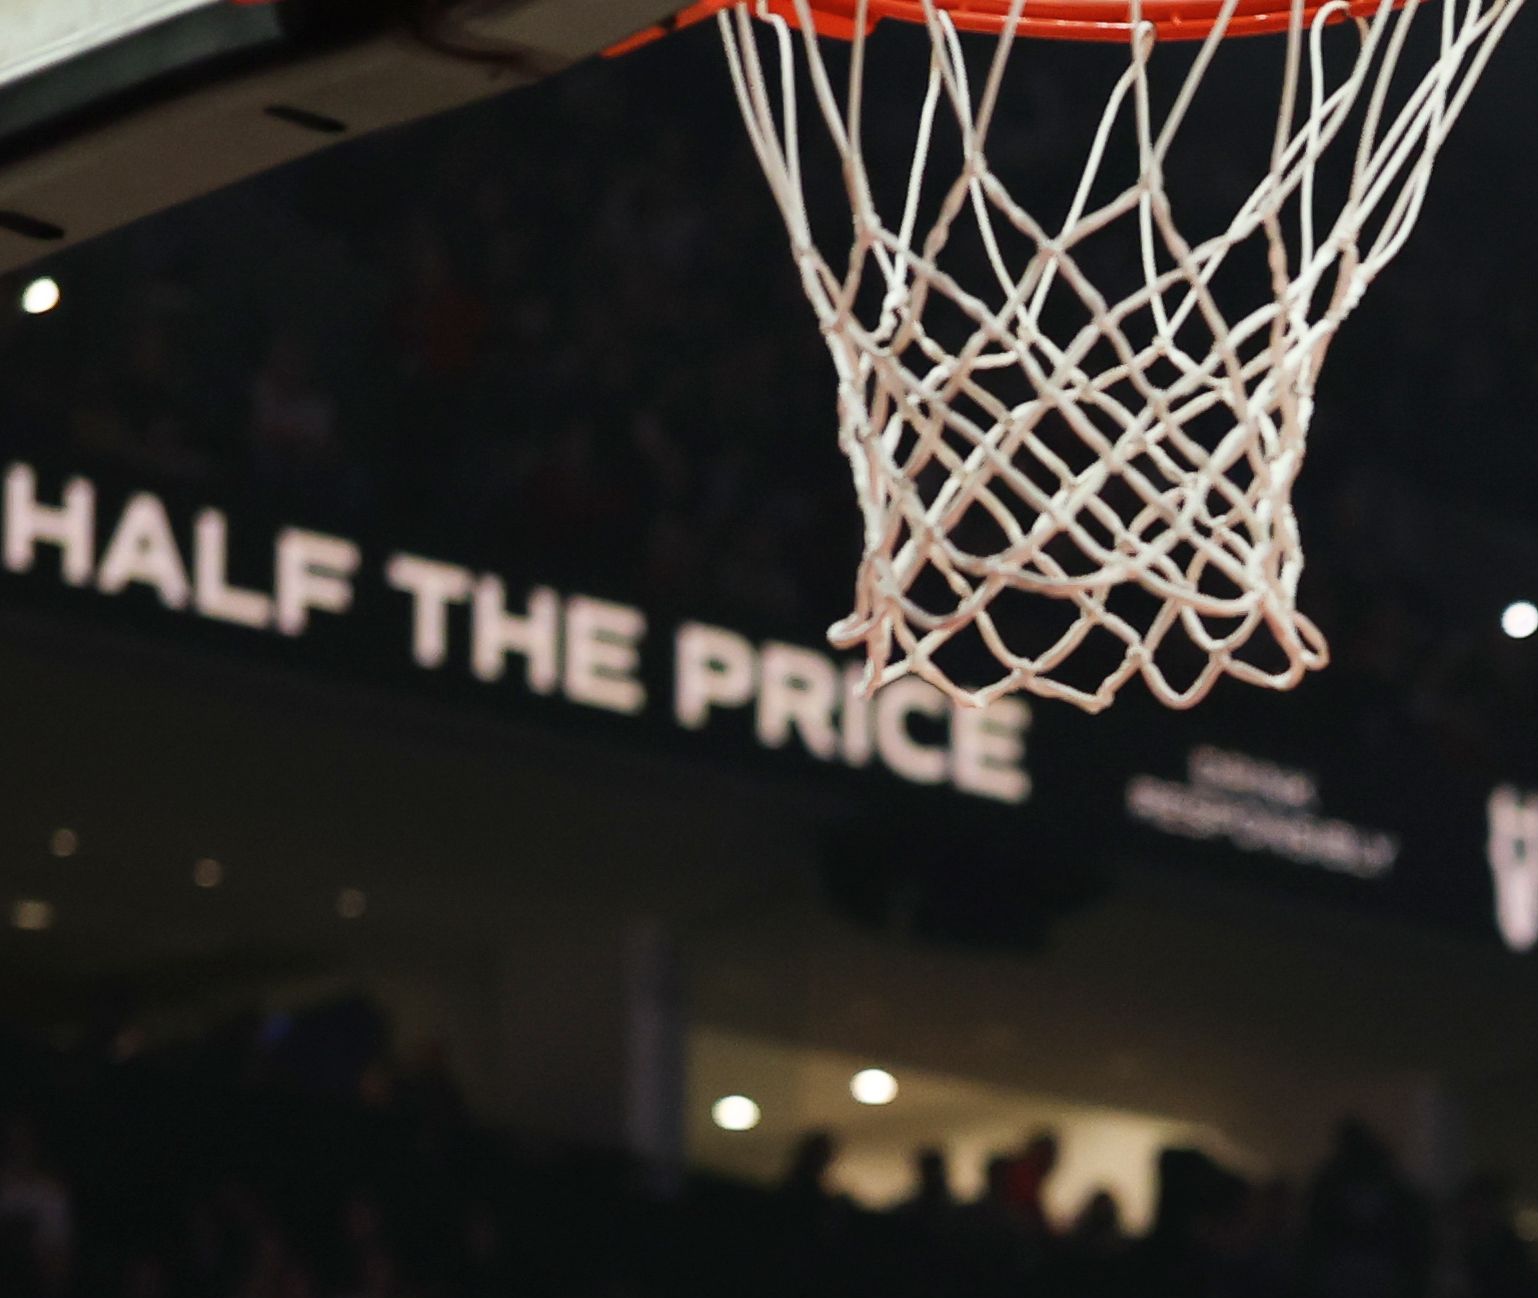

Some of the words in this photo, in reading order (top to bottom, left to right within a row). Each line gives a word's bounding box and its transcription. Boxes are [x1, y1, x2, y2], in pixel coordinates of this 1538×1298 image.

[3, 462, 360, 635] HALF
[386, 553, 646, 712] THE
[674, 622, 1032, 802] PRICE
